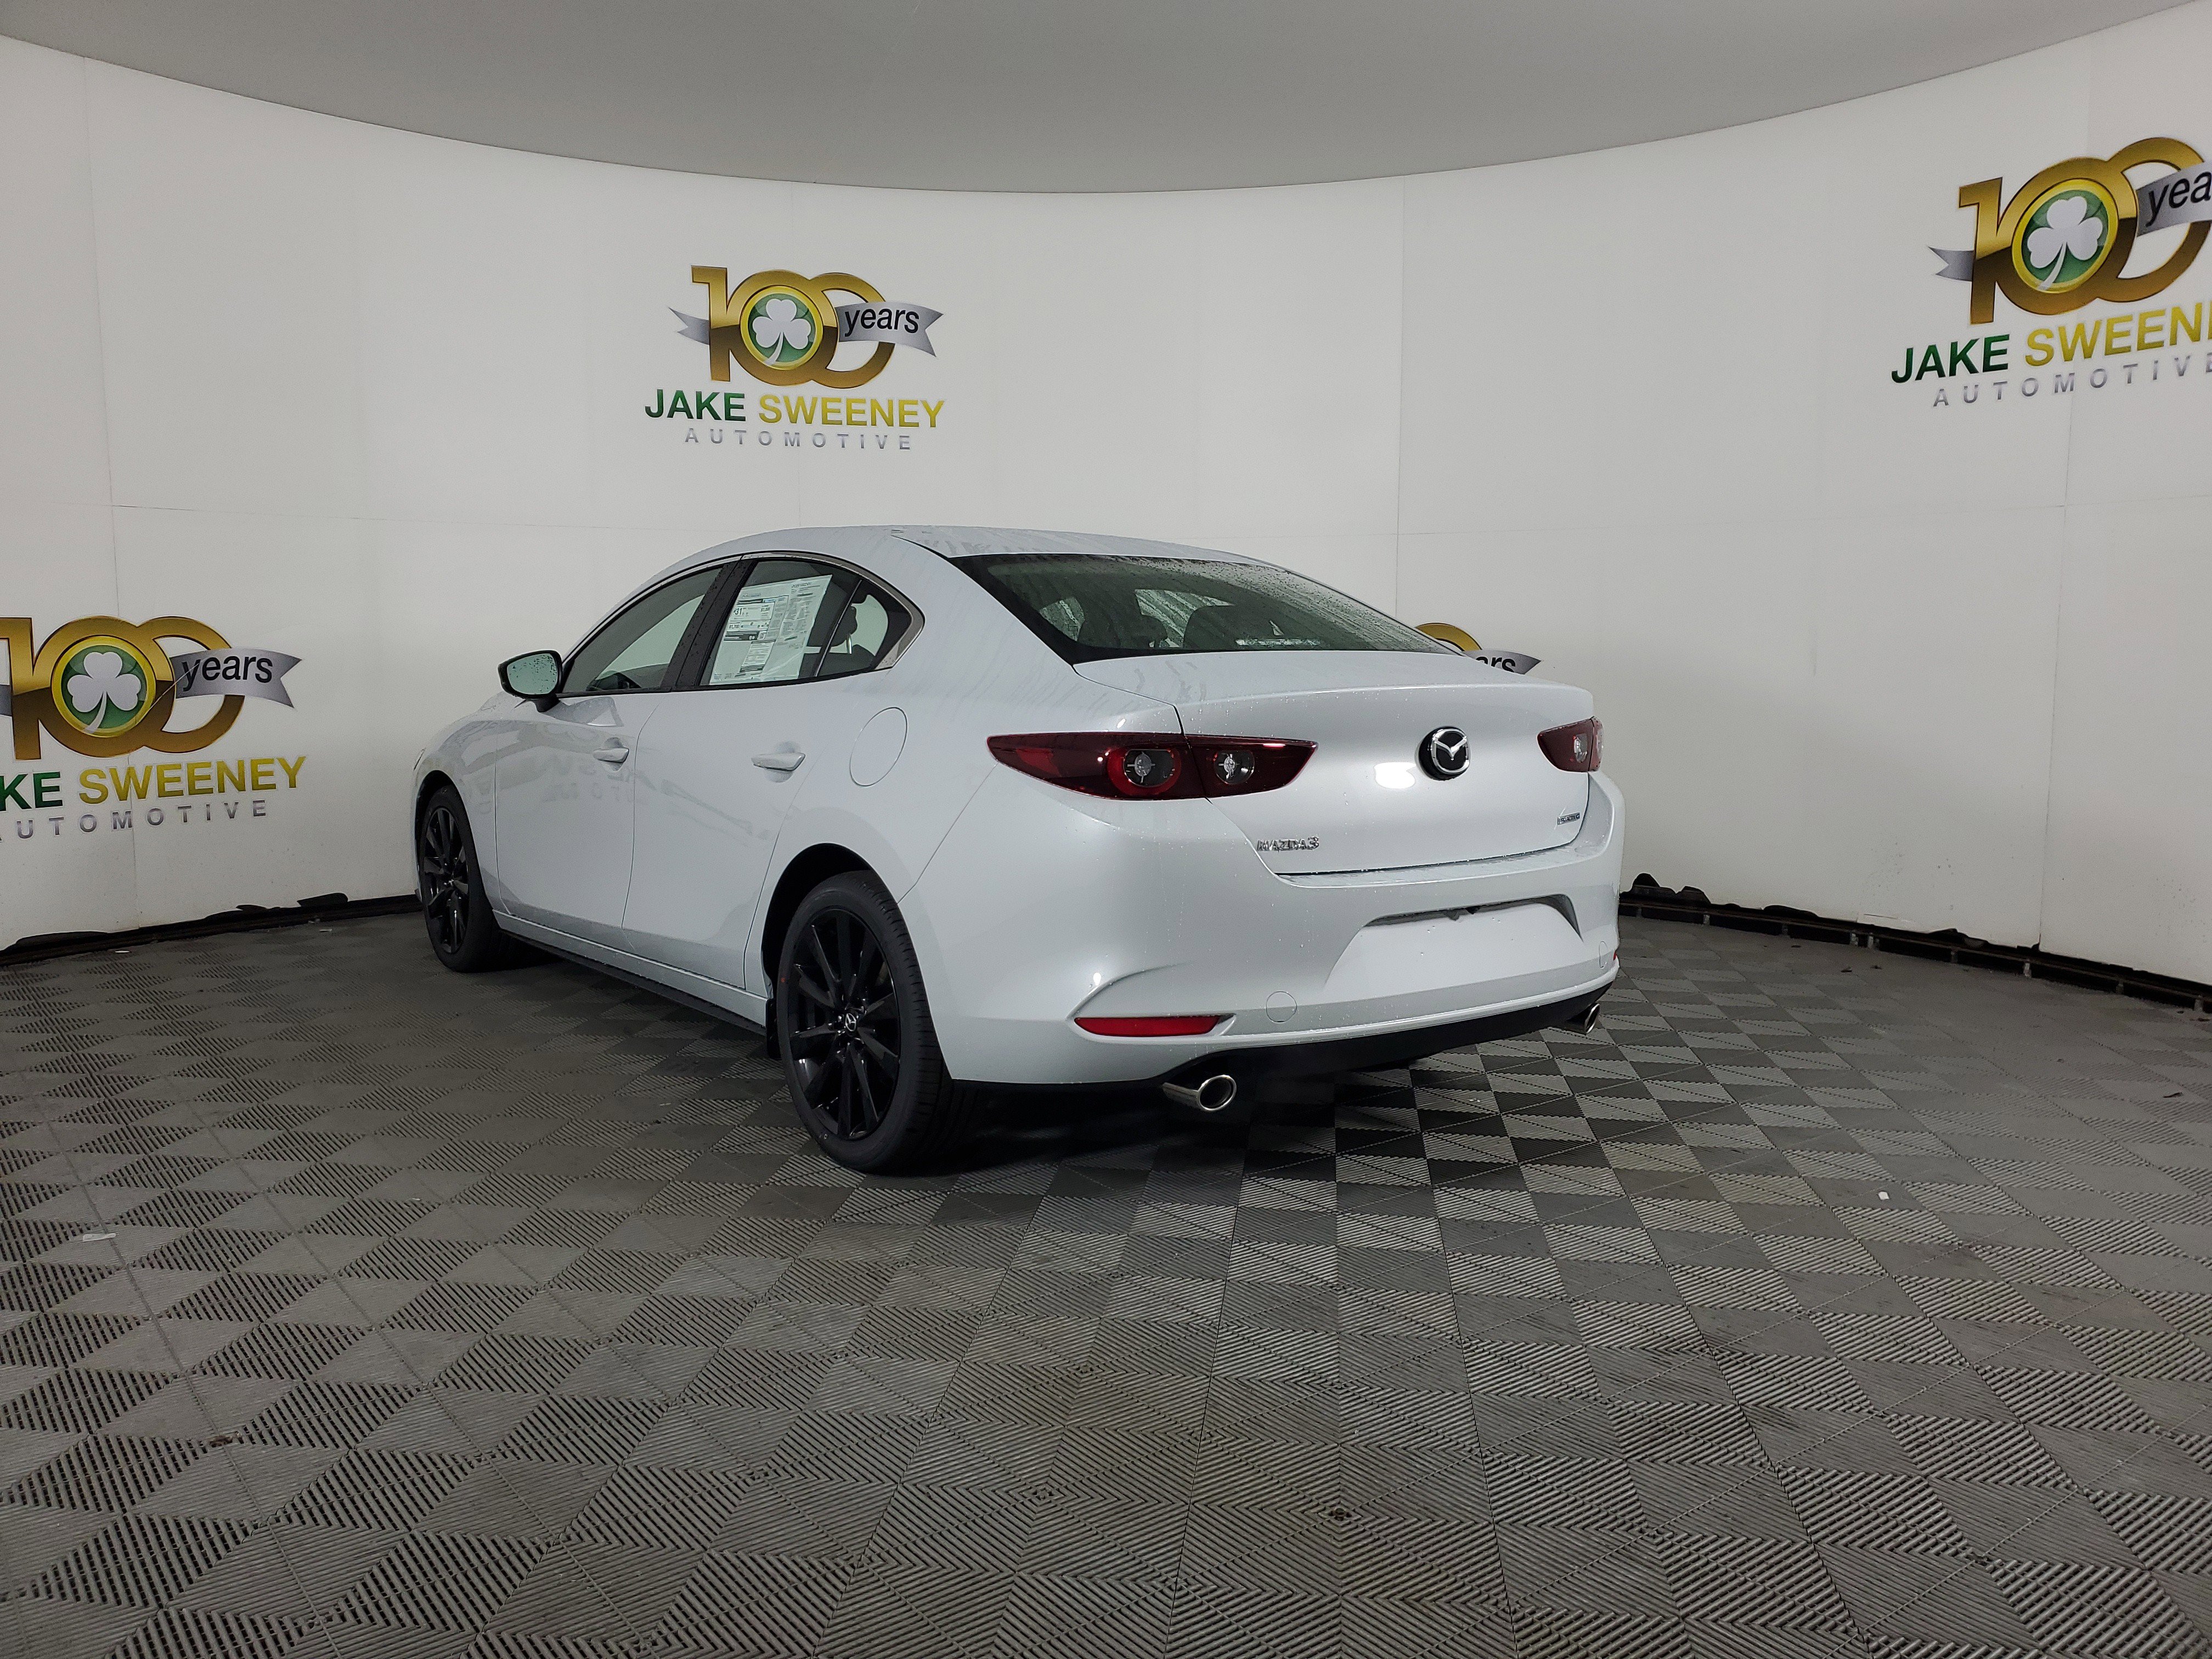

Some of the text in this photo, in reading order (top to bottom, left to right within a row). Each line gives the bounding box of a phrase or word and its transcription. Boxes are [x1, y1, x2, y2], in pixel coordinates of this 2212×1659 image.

[1959, 137, 2210, 324] 100
[691, 265, 895, 388] 100
[844, 308, 919, 337] years
[1891, 300, 2212, 383] JAKE SWEEN
[645, 389, 945, 427] JAKE SWEENEY
[685, 427, 911, 450] AUTOMOTIVE
[182, 656, 273, 692] years
[78, 756, 307, 804] SWEENEY
[0, 800, 266, 842] UTOMOTIVE
